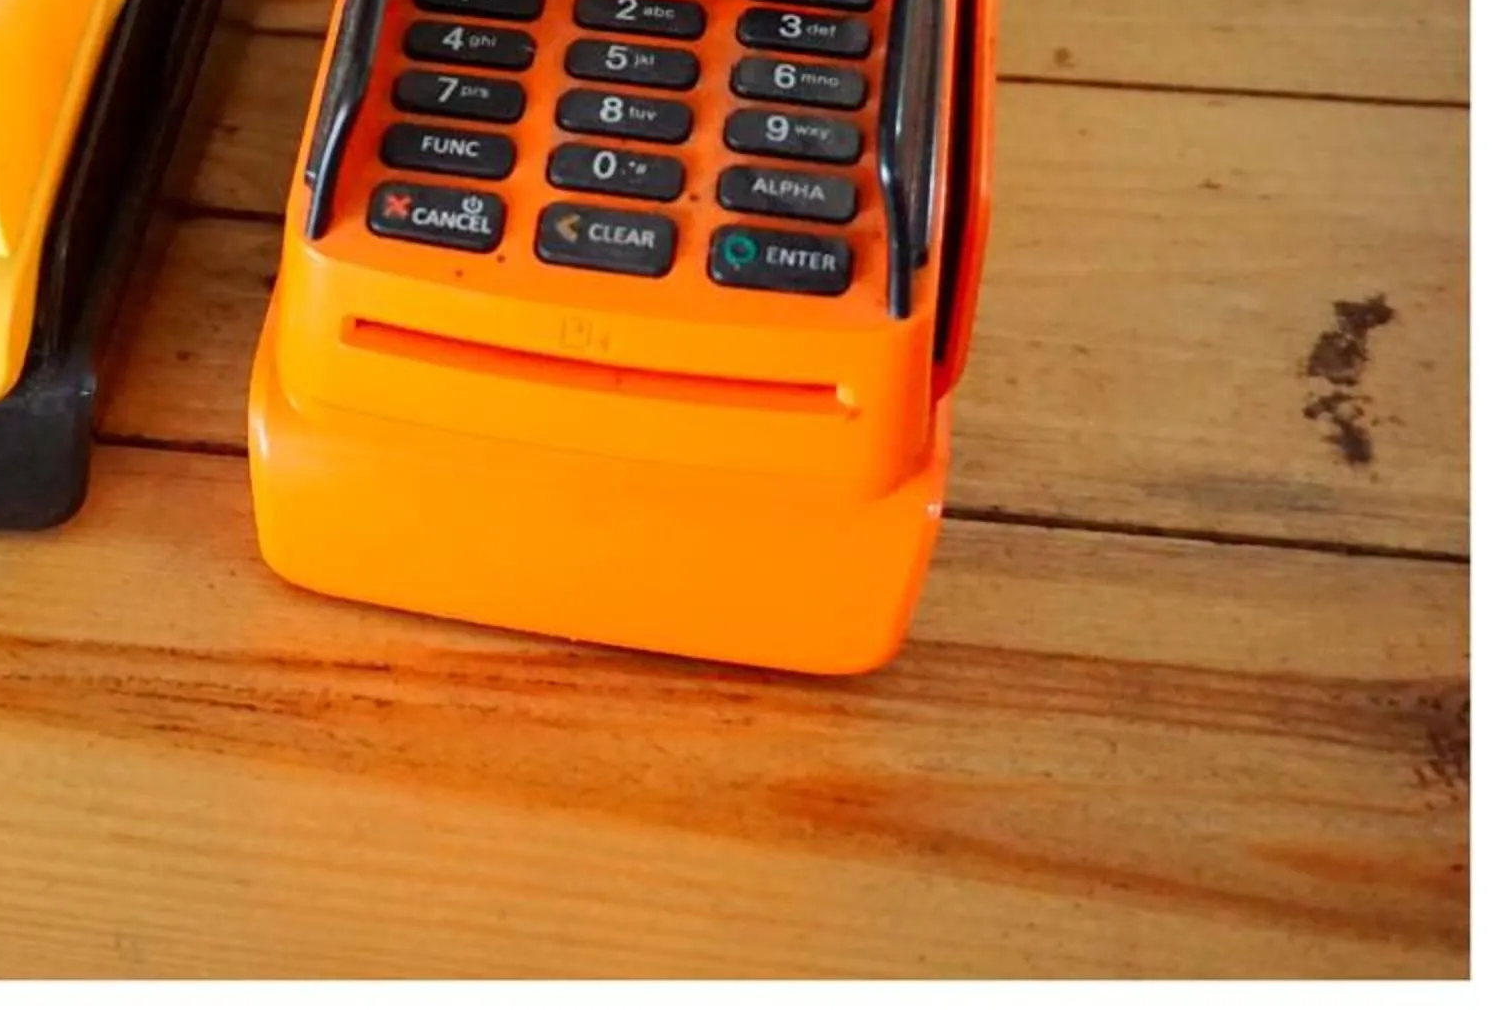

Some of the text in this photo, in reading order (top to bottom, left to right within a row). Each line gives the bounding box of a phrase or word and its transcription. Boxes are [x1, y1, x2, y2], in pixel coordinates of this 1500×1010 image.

[642, 4, 676, 21] abc
[442, 26, 466, 51] 4
[779, 14, 838, 39] 3 def
[605, 46, 628, 71] 5
[438, 76, 459, 102] 7
[774, 64, 841, 89] 6 mno
[600, 96, 624, 123] 8
[765, 115, 789, 142] 9
[420, 136, 482, 158] FUNC
[593, 151, 617, 180] 0
[752, 177, 826, 201] ALPHA
[411, 207, 493, 235] CANCEL
[587, 223, 656, 249] CLEAR
[766, 246, 837, 272] ENTER
